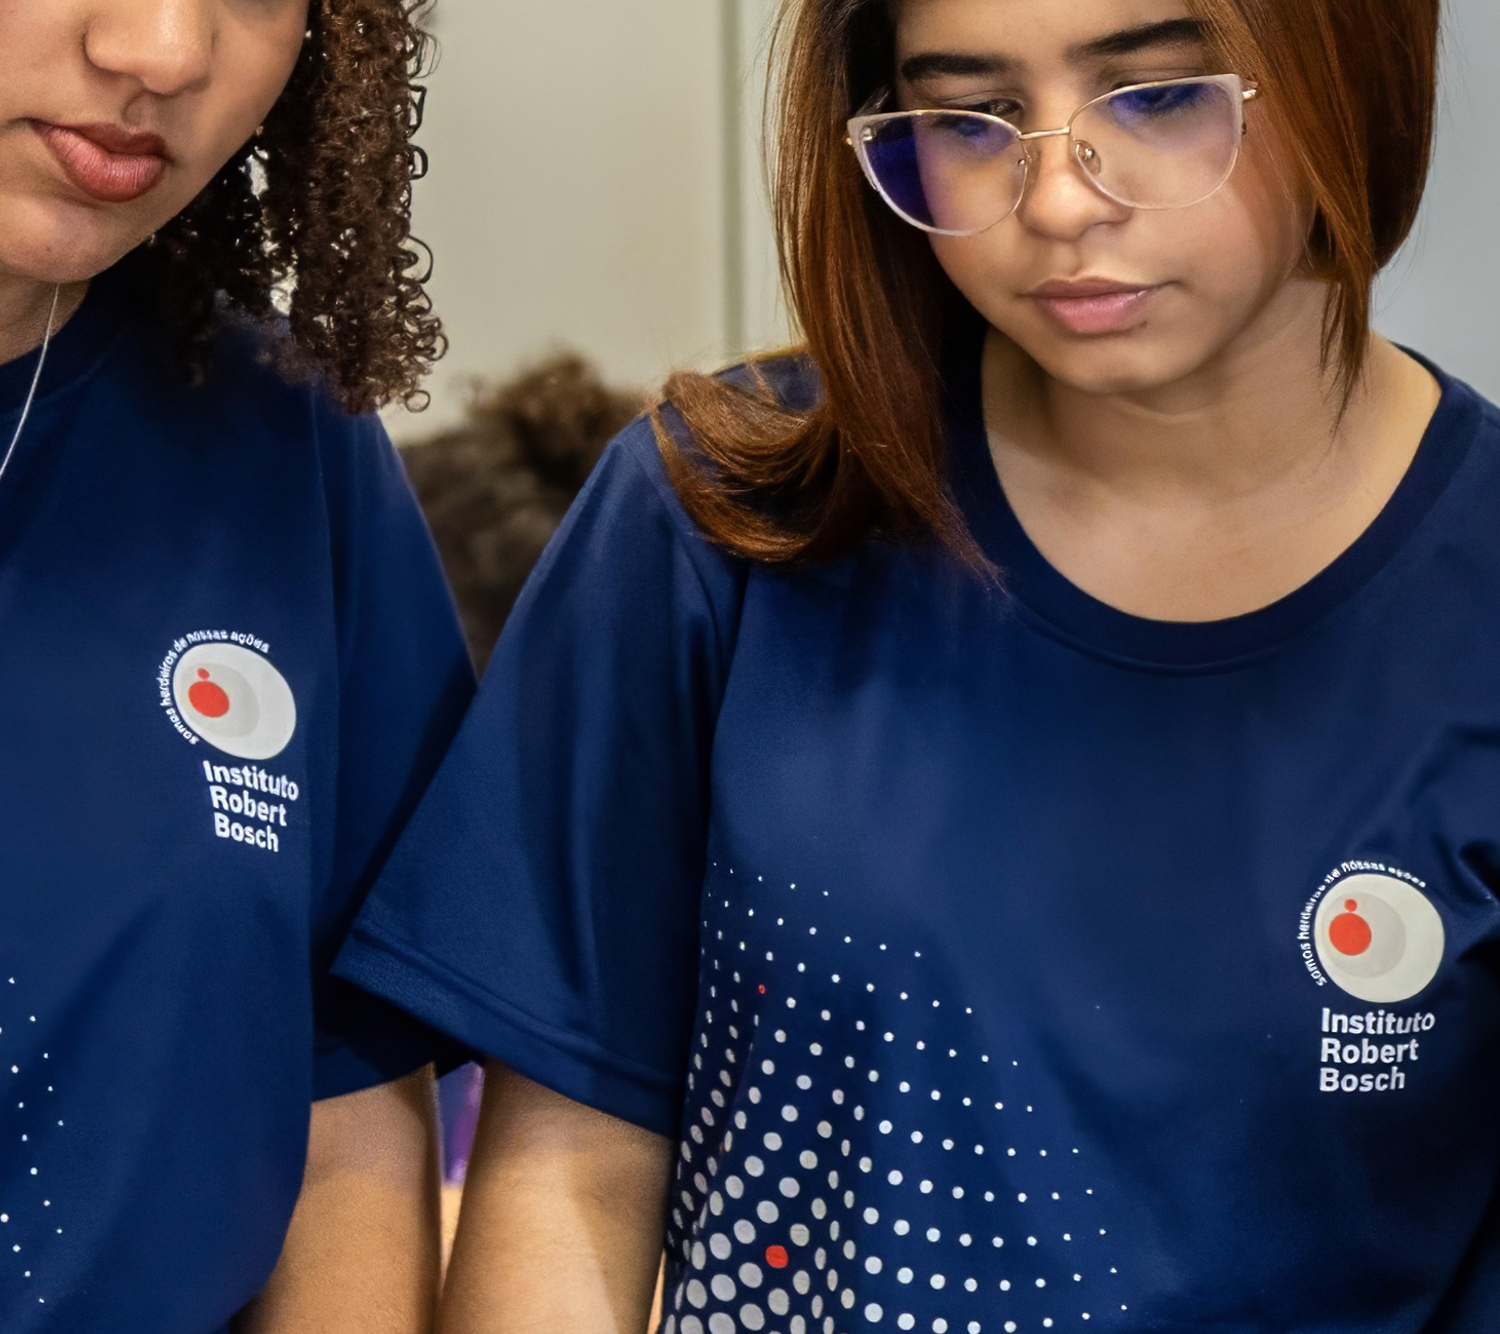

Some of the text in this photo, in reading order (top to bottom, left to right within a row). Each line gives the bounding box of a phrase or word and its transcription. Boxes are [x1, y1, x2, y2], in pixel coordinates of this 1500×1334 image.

[202, 760, 299, 801] Instituto
[209, 785, 287, 827] Robert
[214, 812, 278, 852] Bosch
[1321, 1007, 1435, 1034] Instituto
[1320, 1038, 1419, 1064] Robert
[1319, 1066, 1405, 1092] Bosch
